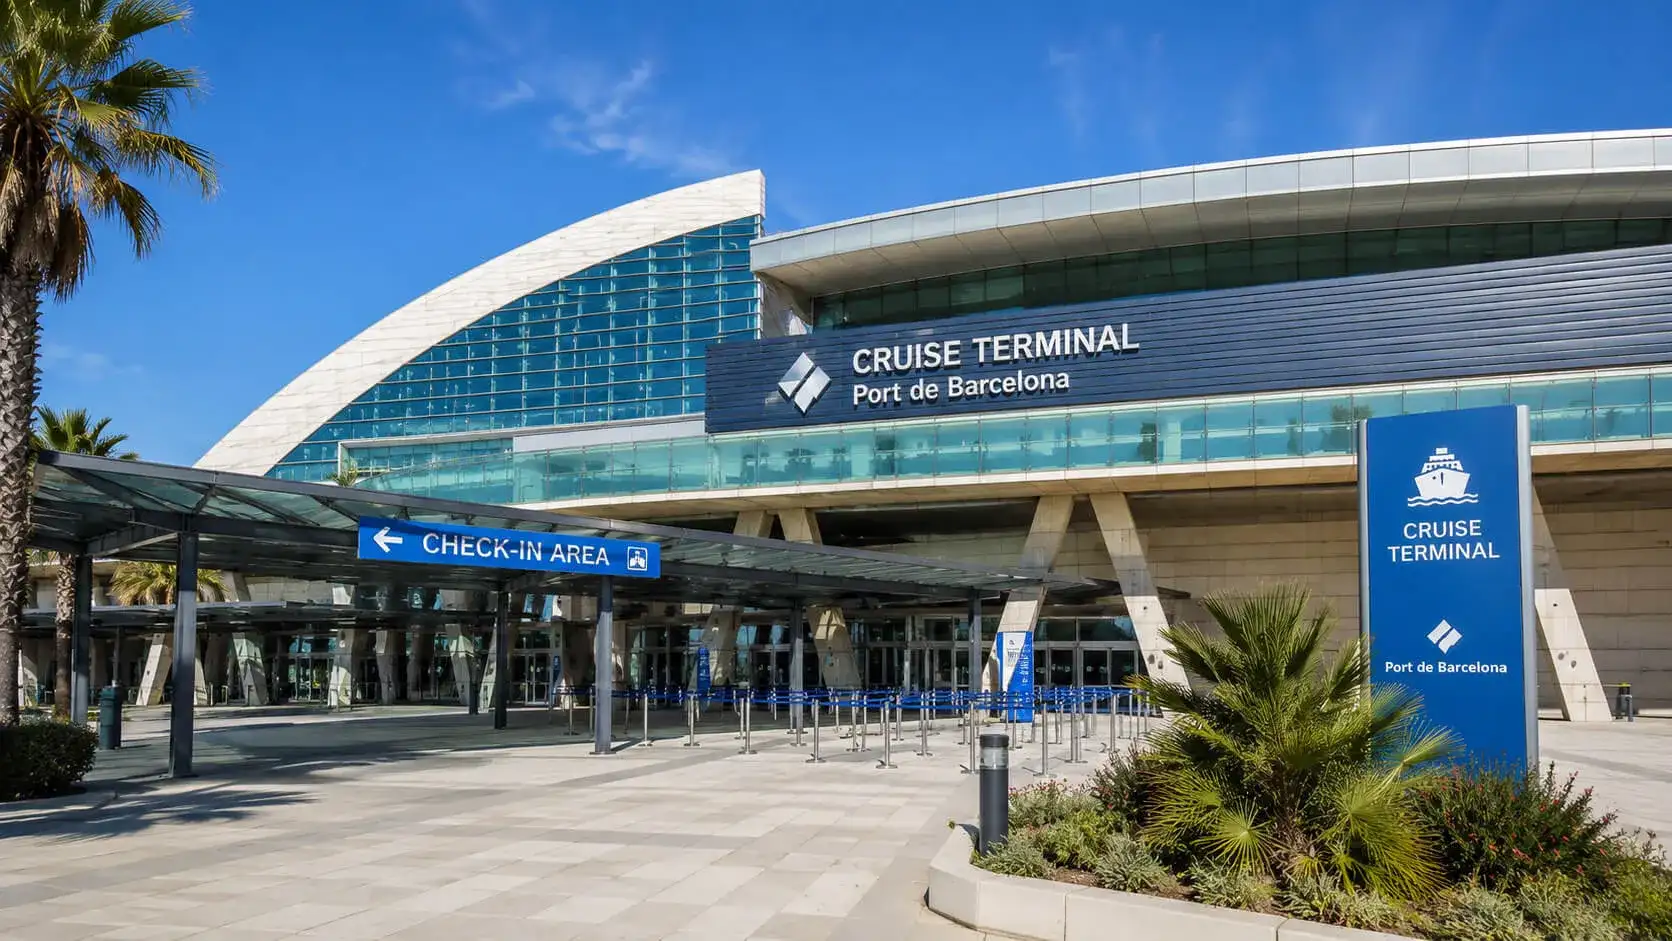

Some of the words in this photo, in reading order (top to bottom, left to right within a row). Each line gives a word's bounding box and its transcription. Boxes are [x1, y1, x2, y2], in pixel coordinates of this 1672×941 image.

[852, 340, 961, 374] CRUISE
[972, 323, 1140, 363] TERMINAL
[852, 383, 901, 405] Port
[910, 379, 938, 399] de
[948, 370, 1070, 398] Barcelona
[1403, 519, 1482, 539] CRUISE
[423, 533, 542, 561] CHECK-IN
[550, 544, 610, 566] AREA
[1387, 542, 1500, 562] TERMINAL
[1385, 661, 1413, 673] Port
[1417, 661, 1433, 673] de
[1438, 661, 1507, 673] Barcelona
